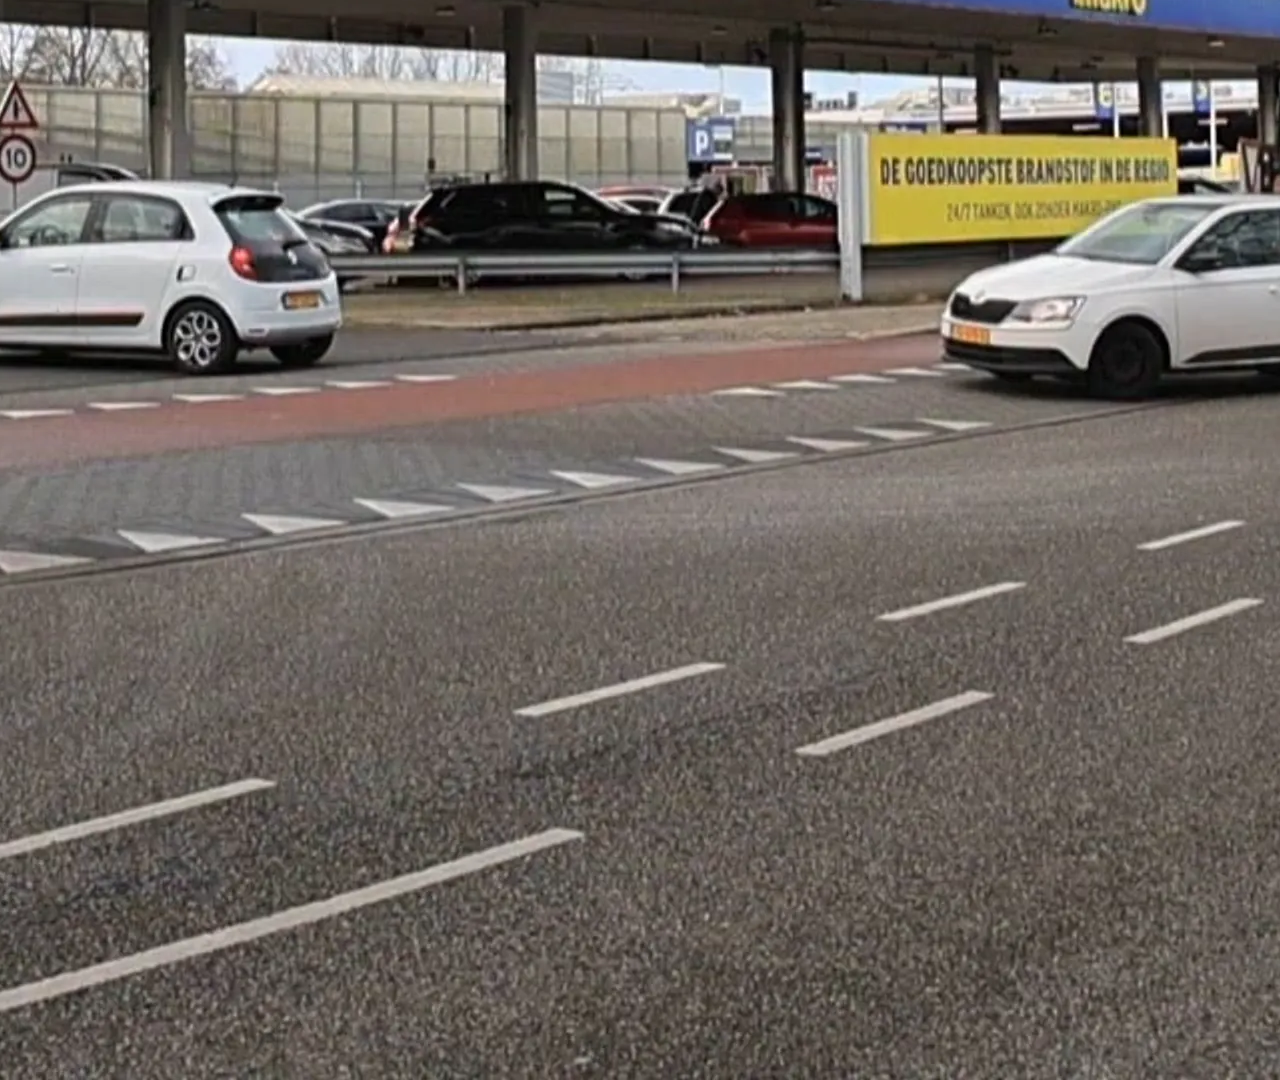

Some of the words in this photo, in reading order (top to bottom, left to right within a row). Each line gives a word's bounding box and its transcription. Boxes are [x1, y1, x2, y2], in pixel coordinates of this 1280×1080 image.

[695, 129, 709, 156] P
[6, 147, 27, 169] 10
[880, 157, 900, 185] DE
[904, 157, 1013, 185] GOEDKOOPSTE
[1016, 157, 1096, 183] BRANDSTOF
[1100, 157, 1113, 183] IN
[1115, 157, 1131, 183] DE
[1134, 157, 1169, 183] REGIO
[946, 202, 971, 222] 24/7
